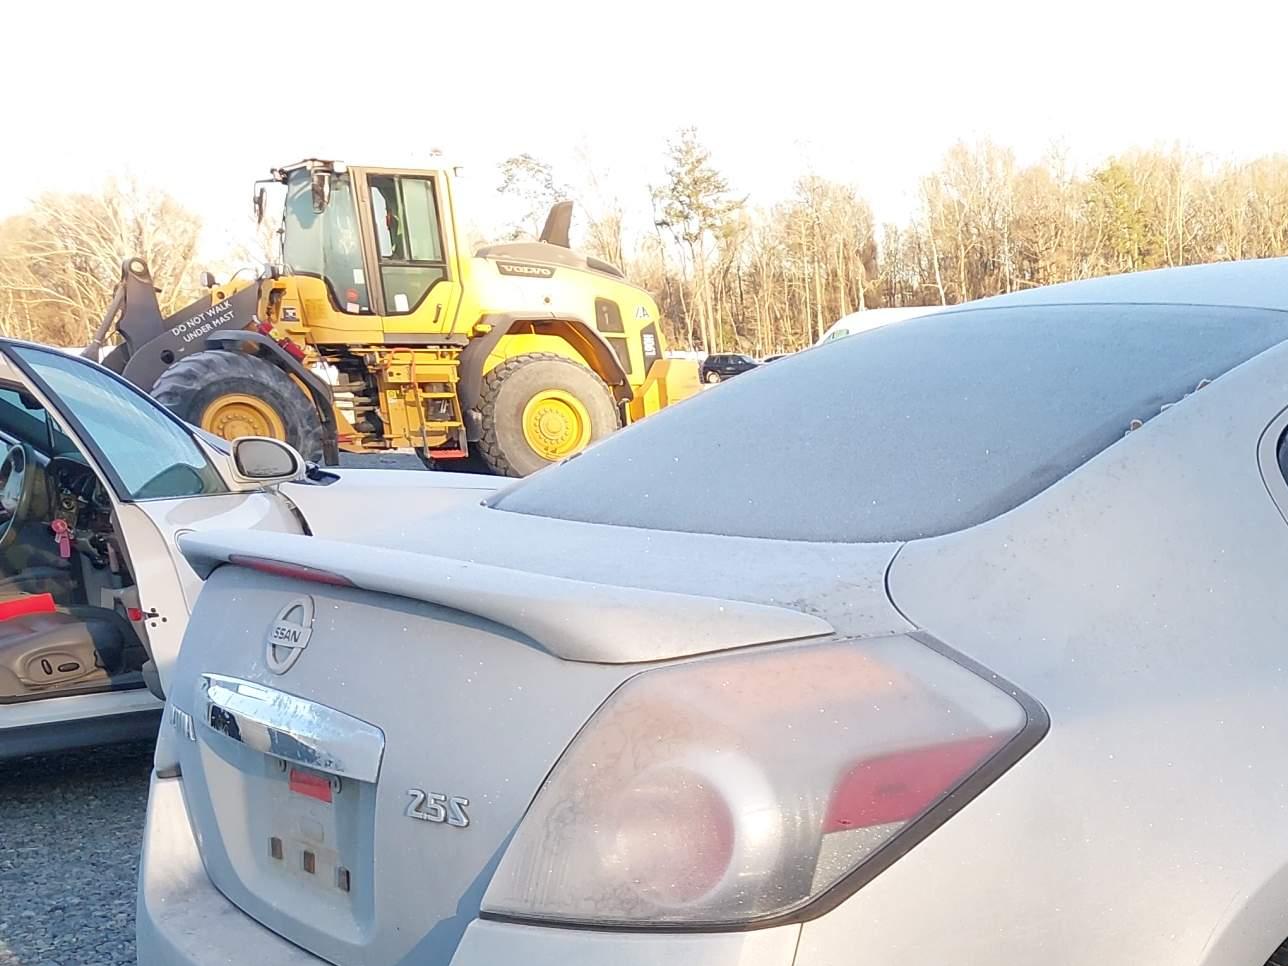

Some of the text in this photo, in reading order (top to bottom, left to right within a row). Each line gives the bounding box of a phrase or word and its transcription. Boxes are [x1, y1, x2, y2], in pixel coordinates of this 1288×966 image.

[501, 264, 551, 275] VOLVO
[171, 300, 233, 336] DO NOT WALK
[182, 311, 235, 343] UNDER MAST
